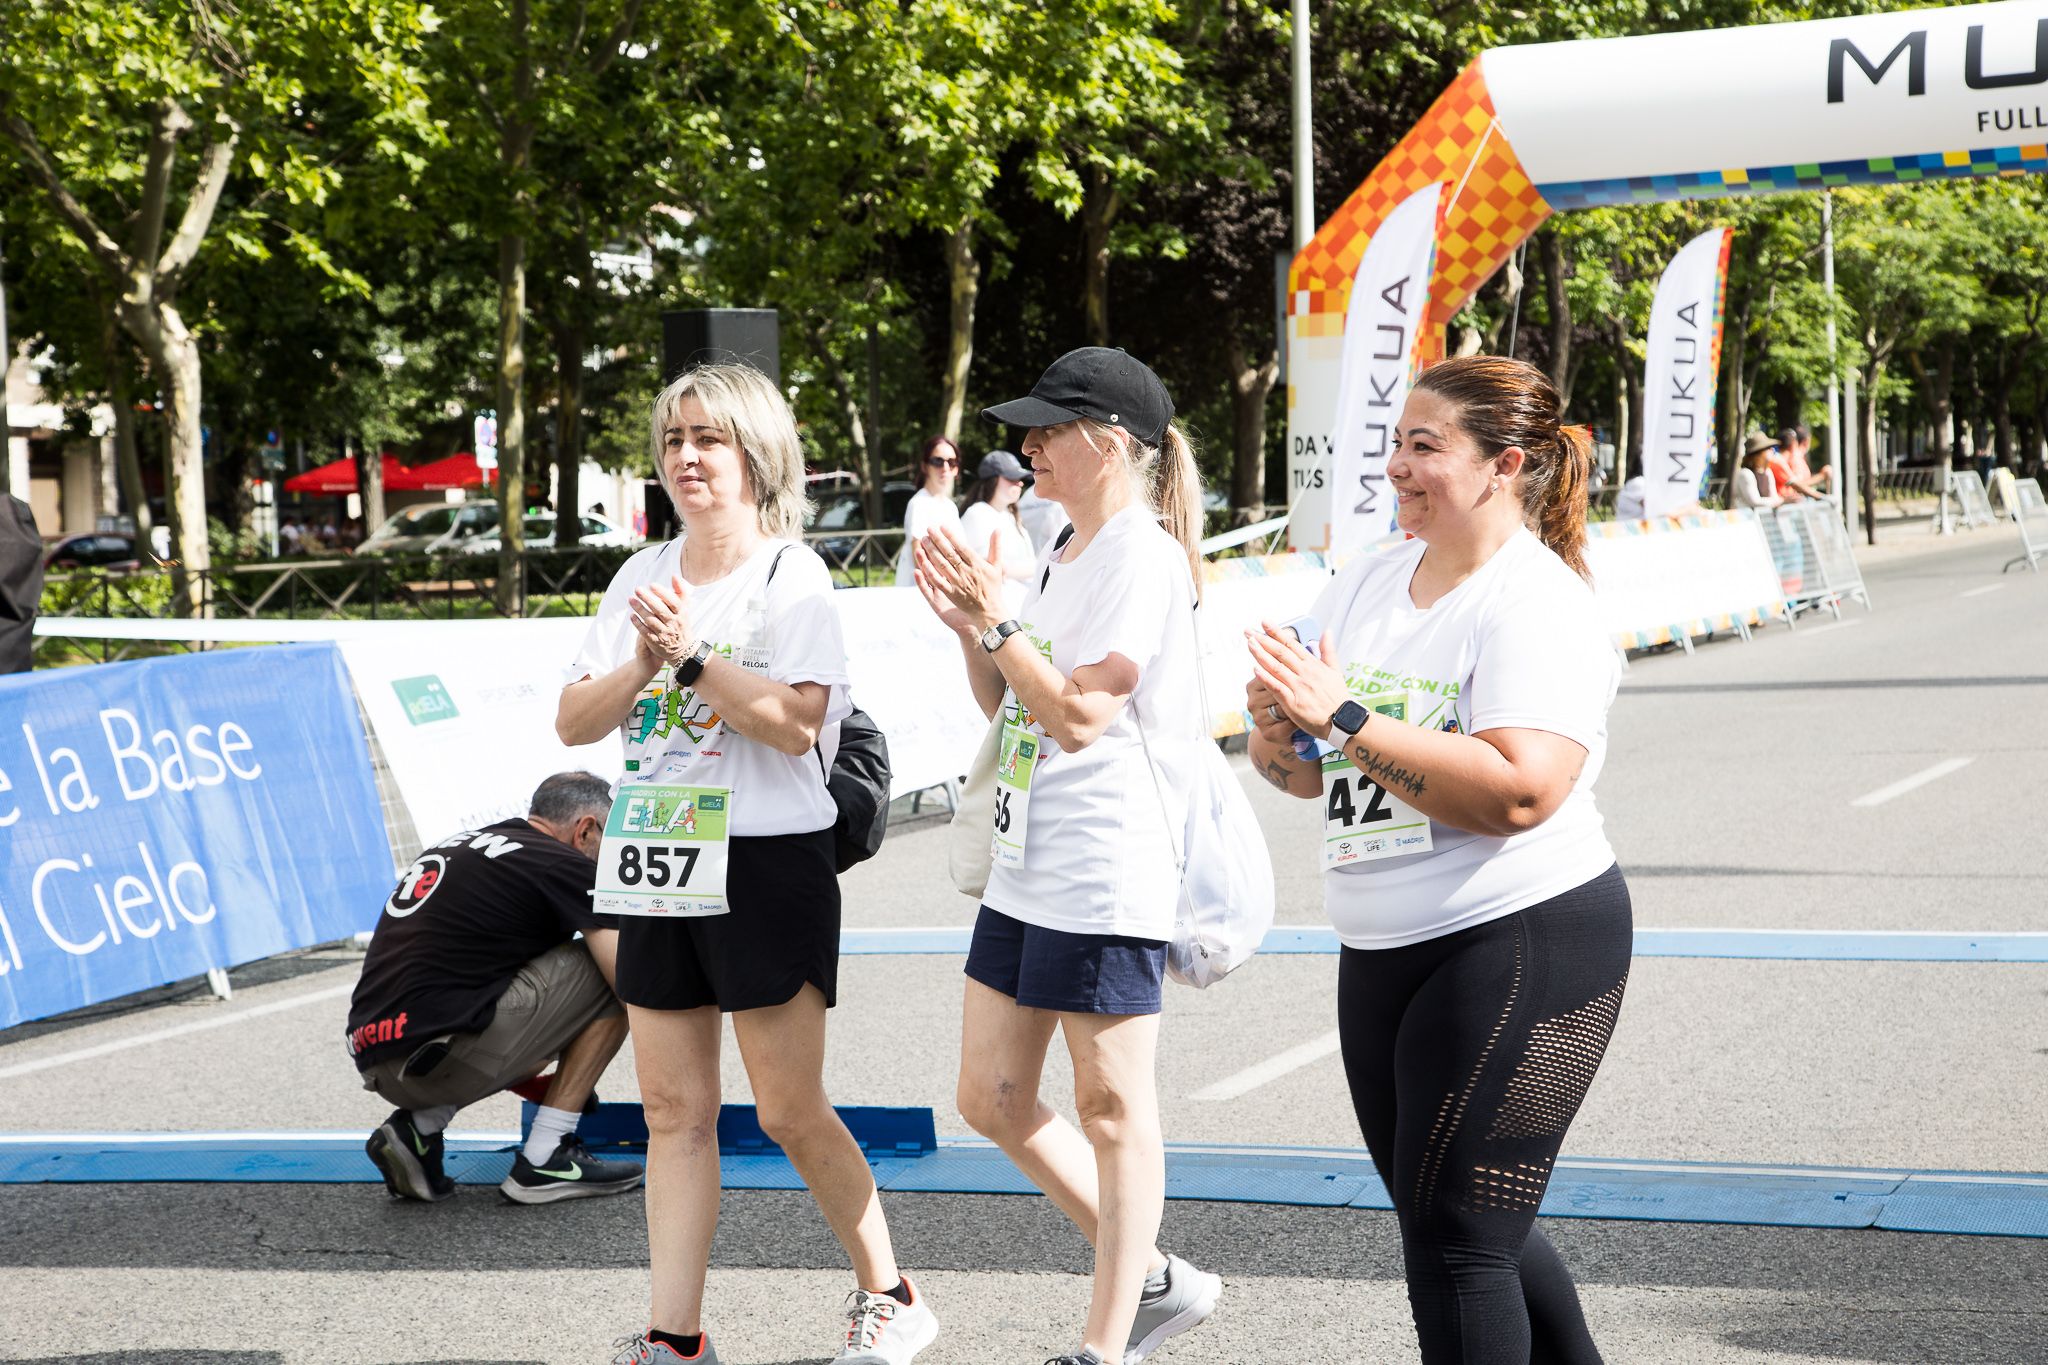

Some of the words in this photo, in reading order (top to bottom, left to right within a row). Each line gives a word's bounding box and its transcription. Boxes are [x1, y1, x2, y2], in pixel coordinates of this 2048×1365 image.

[1977, 106, 2048, 133] FULL
[1353, 275, 1411, 514] MUKUA
[1667, 301, 1700, 484] MUKUA
[1295, 436, 1317, 455] DA
[1294, 469, 1324, 488] TUS
[742, 660, 769, 669] RELOAD
[1401, 677, 1439, 694] CON
[22, 722, 100, 816] la
[99, 708, 262, 801] Base
[621, 797, 697, 834] ELA
[1325, 774, 1393, 829] 42
[618, 844, 701, 888] 857
[1366, 844, 1380, 852] LIFE
[32, 841, 217, 955] Cielo
